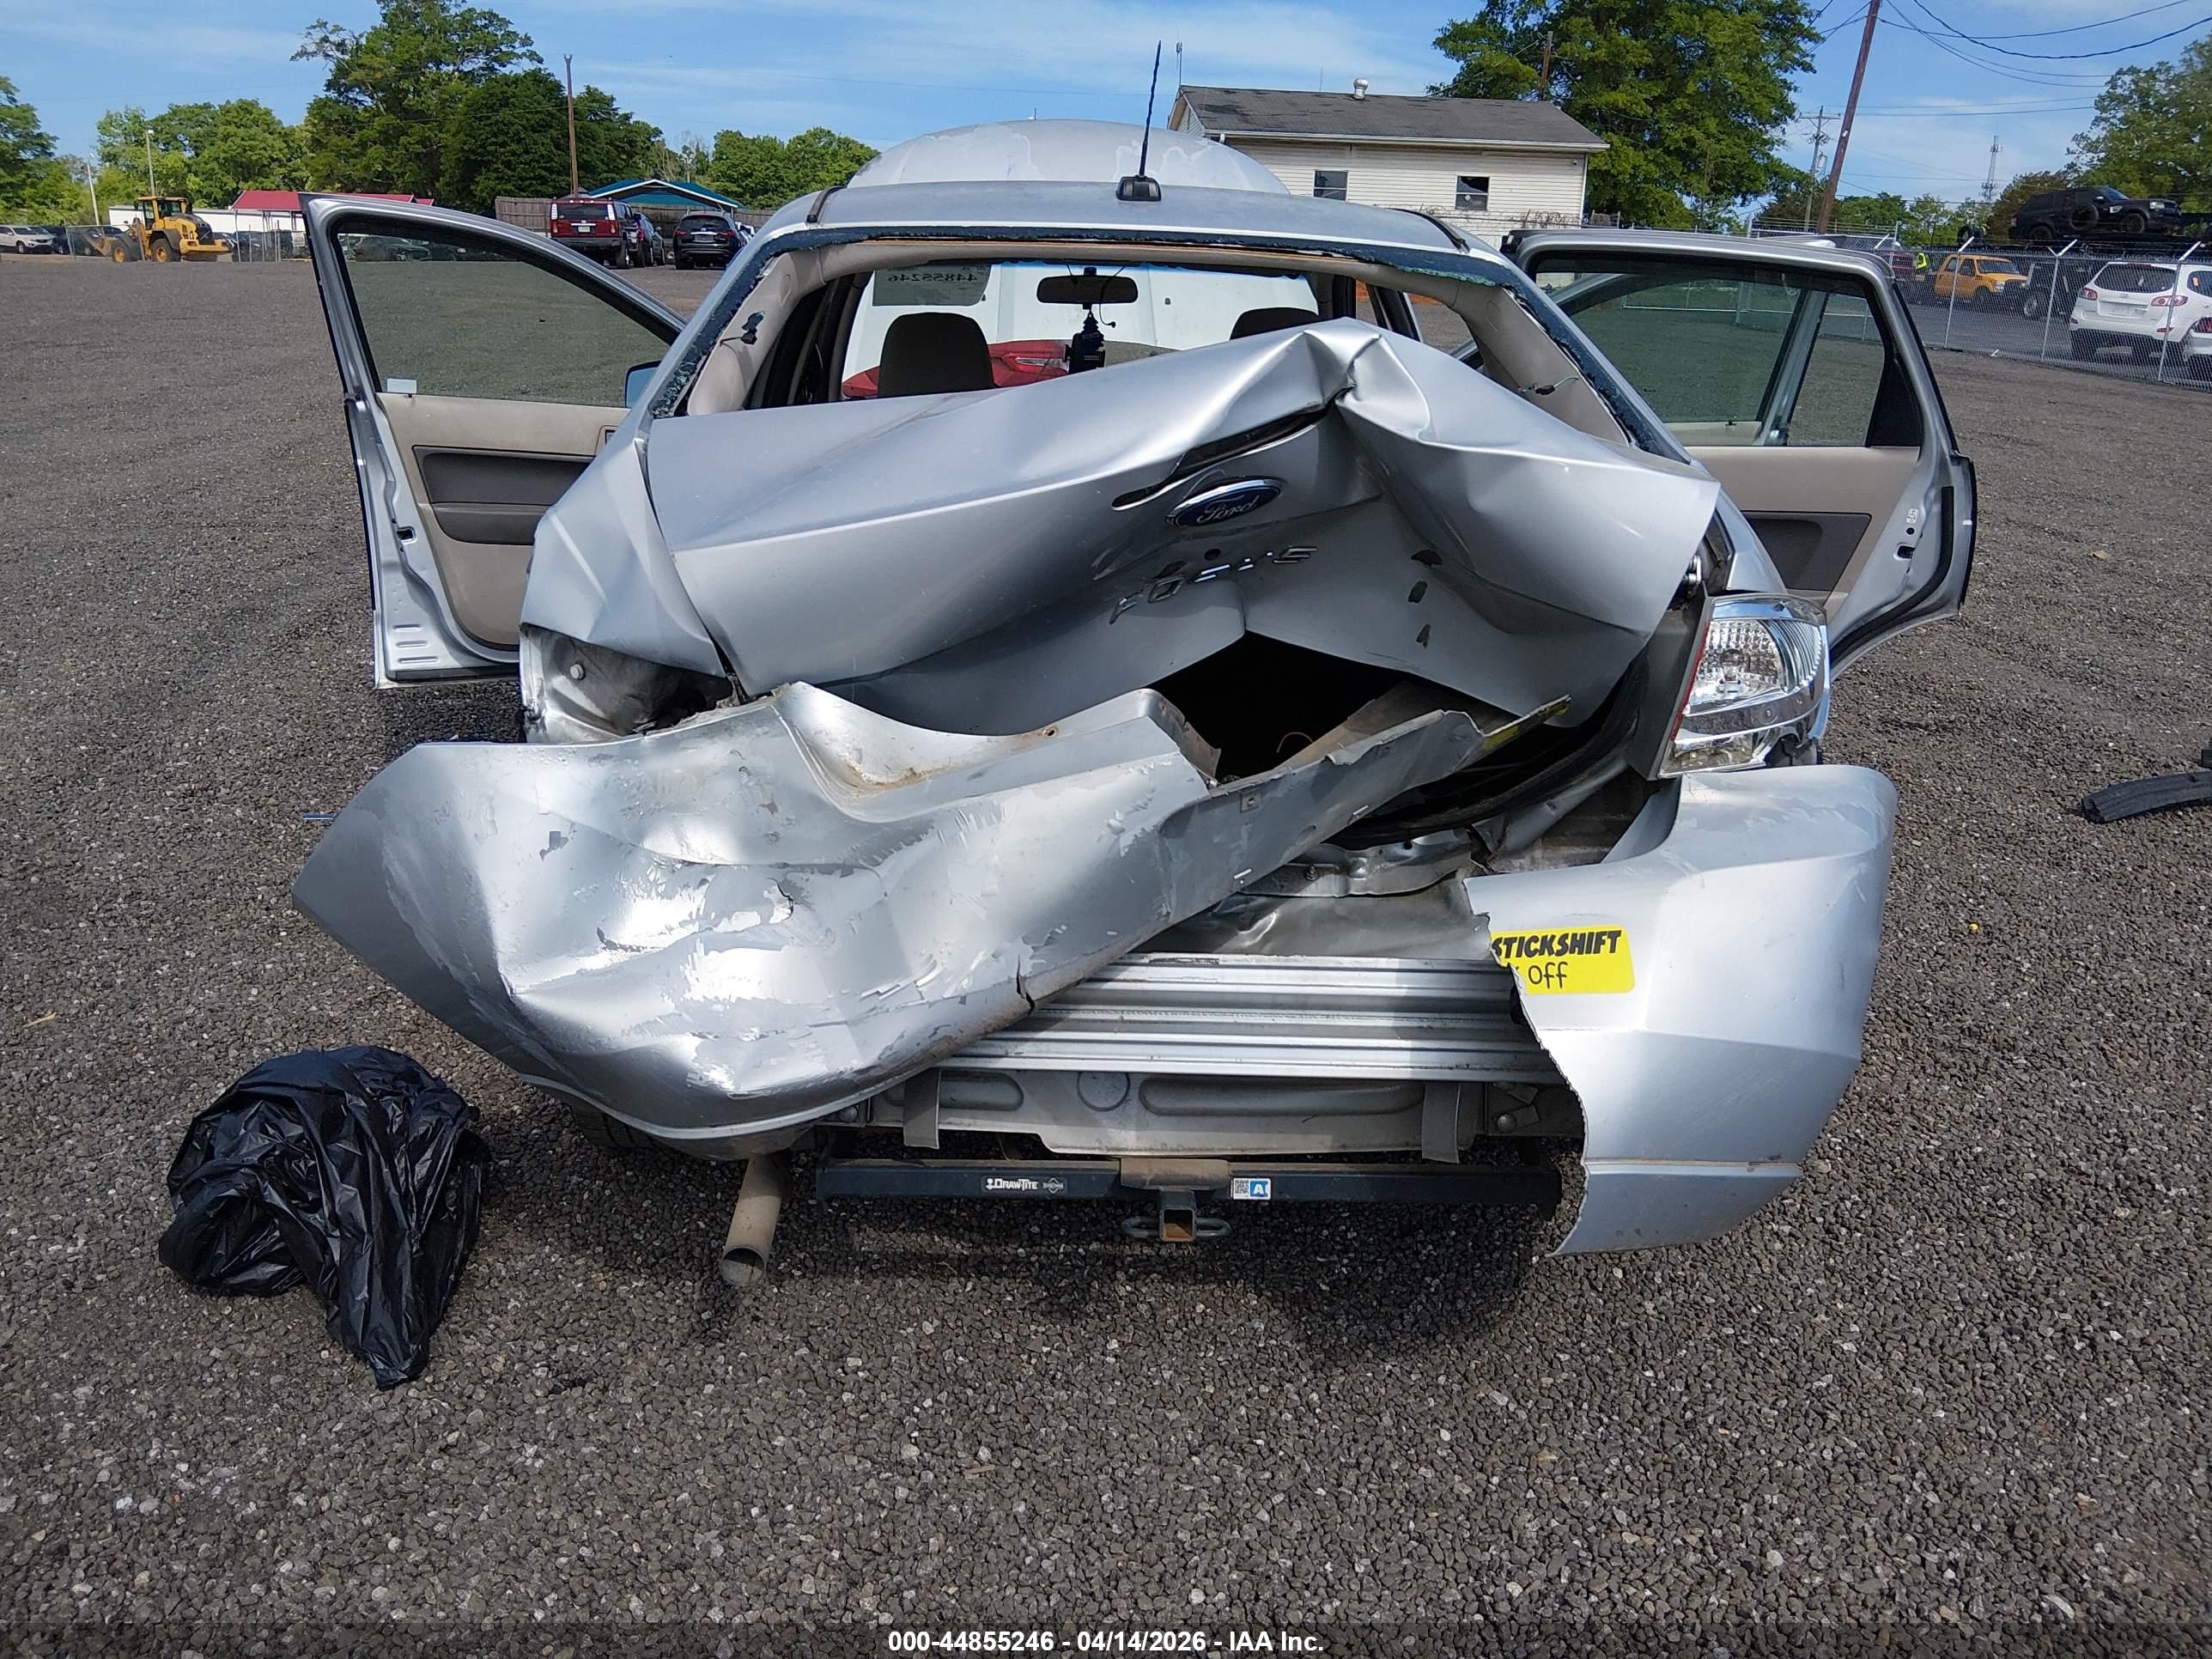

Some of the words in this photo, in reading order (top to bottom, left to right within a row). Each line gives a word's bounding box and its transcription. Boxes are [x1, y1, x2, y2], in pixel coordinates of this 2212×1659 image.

[1196, 494, 1260, 523] Ford
[1492, 930, 1622, 959] STICKSHIFT
[1528, 961, 1568, 989] Off
